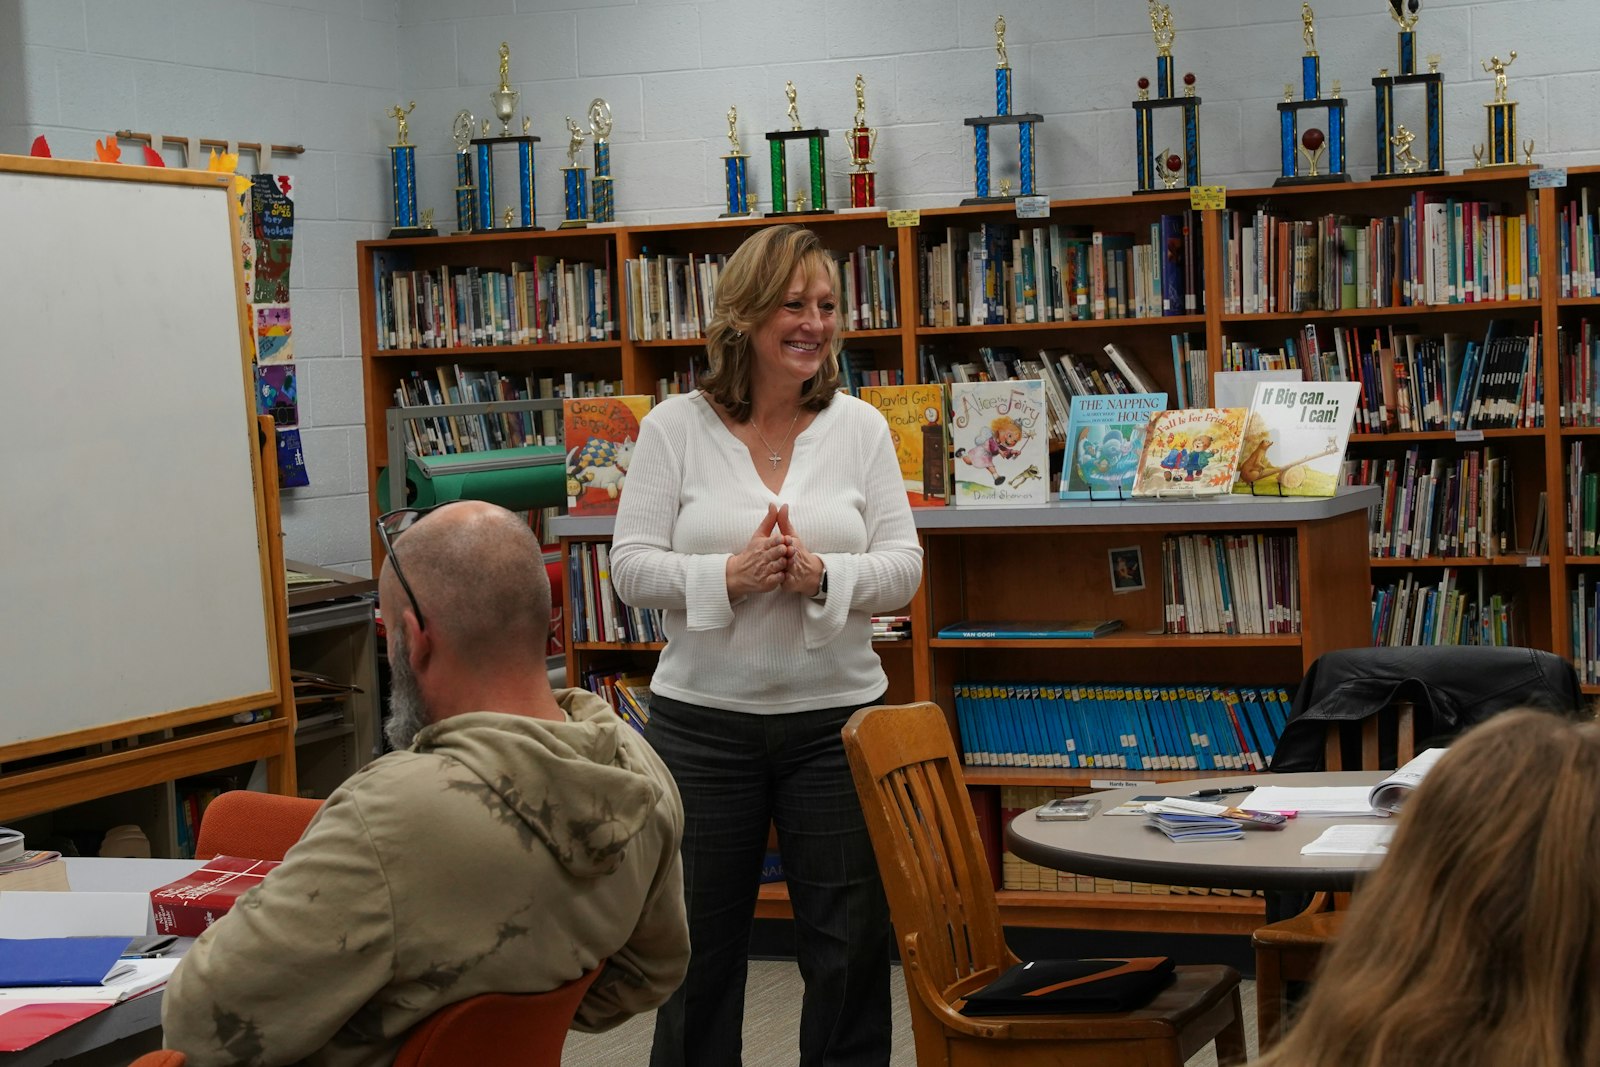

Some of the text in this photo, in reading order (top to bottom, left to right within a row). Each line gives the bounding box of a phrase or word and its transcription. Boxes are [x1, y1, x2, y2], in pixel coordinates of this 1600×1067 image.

[870, 389, 936, 409] David Gets
[1079, 398, 1159, 411] THE NAPPING
[1262, 388, 1274, 405] If
[1275, 388, 1297, 408] Big
[1300, 391, 1324, 405] can
[570, 401, 608, 416] Good
[881, 408, 924, 425] Trouble
[956, 392, 998, 428] Alice
[997, 389, 1040, 428] Fairy
[1117, 411, 1151, 422] HOUS
[1300, 406, 1339, 422] I can!
[1157, 419, 1177, 434] Fall
[1178, 416, 1186, 425] Is
[1188, 413, 1202, 422] for
[973, 489, 996, 501] David
